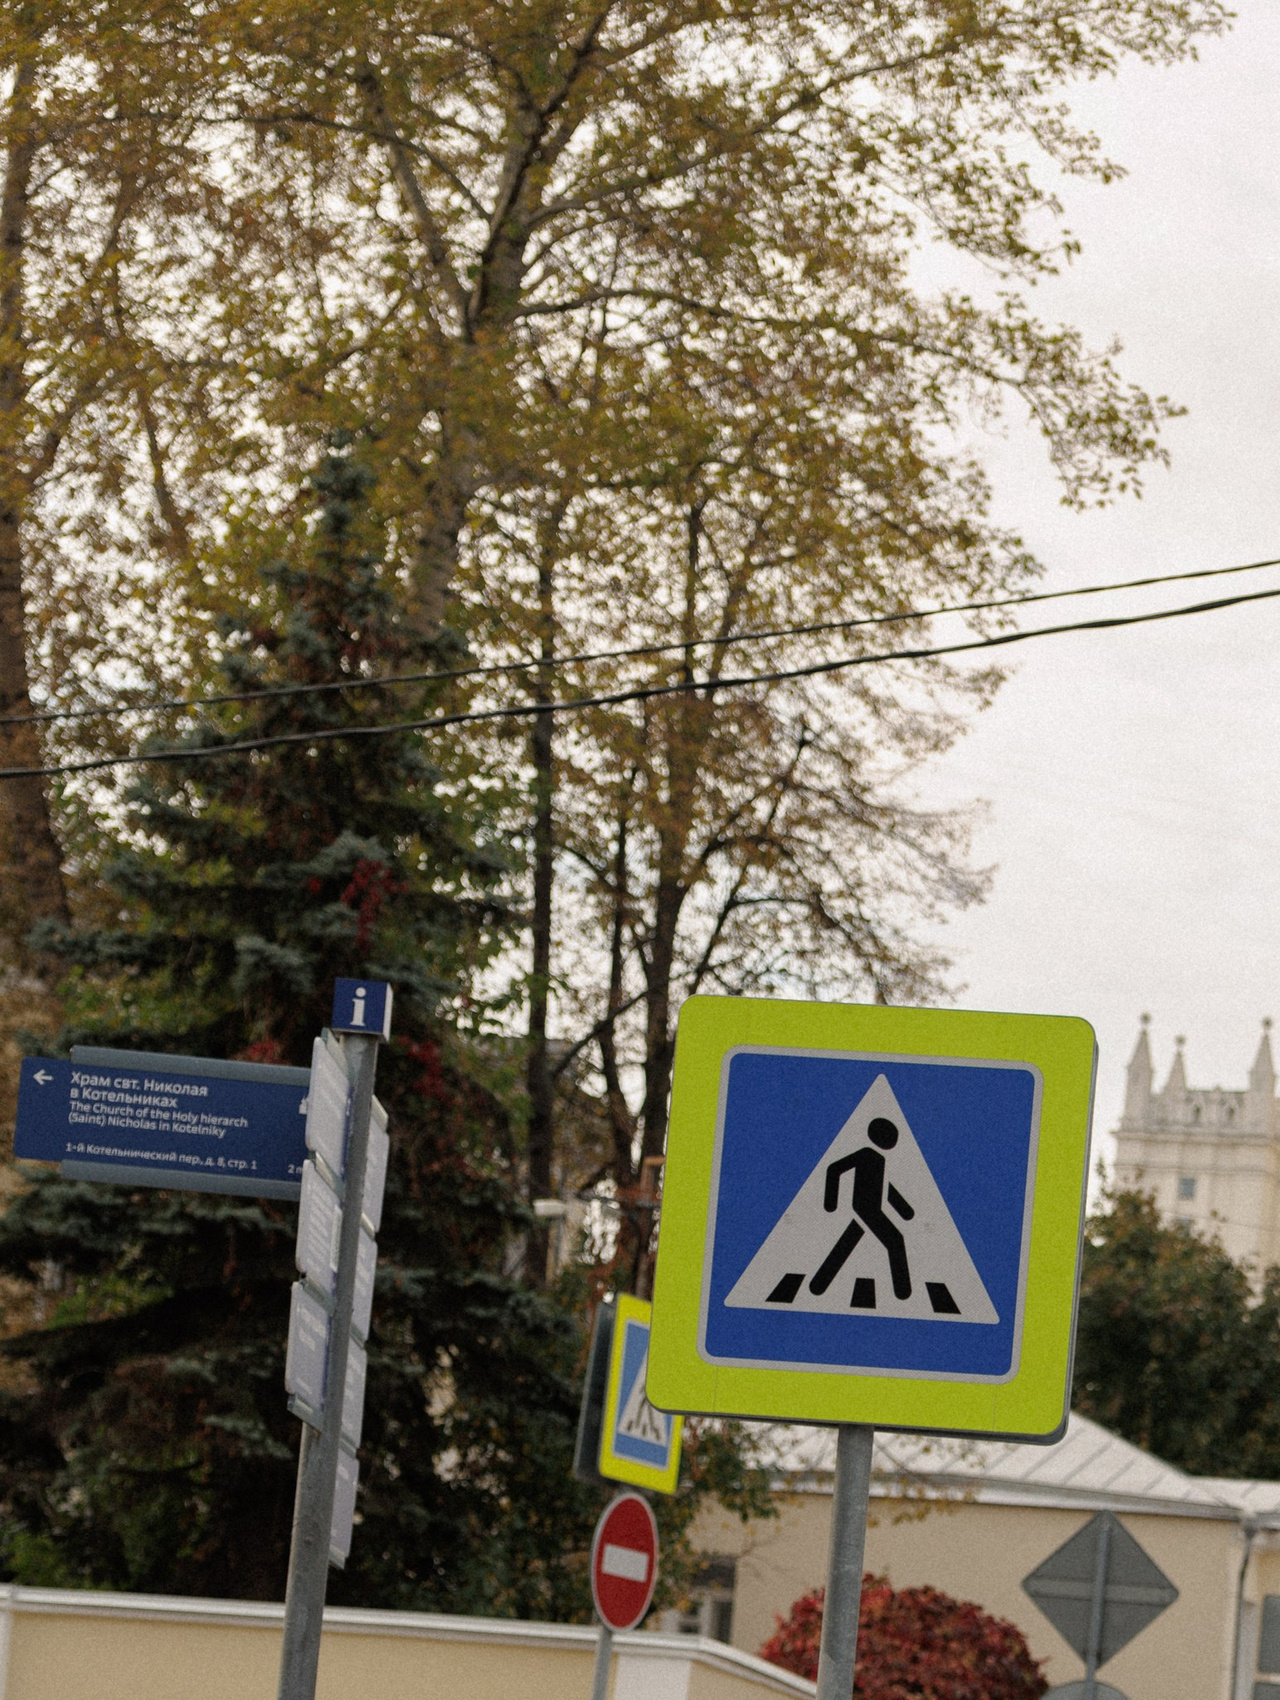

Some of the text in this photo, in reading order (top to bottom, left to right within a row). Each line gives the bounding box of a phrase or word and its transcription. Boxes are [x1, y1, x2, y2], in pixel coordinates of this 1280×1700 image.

[71, 1071, 208, 1096] Храм свт. Николая
[70, 1088, 178, 1108] в Котельниках
[68, 1112, 226, 1138] (Saint) Nicholas in Kotelniky
[70, 1101, 248, 1128] The Church of the Holy hierarch
[66, 1142, 84, 1153] 1-й
[86, 1144, 176, 1161] Котельнический
[228, 1159, 249, 1170] стр.
[251, 1160, 257, 1170] 1
